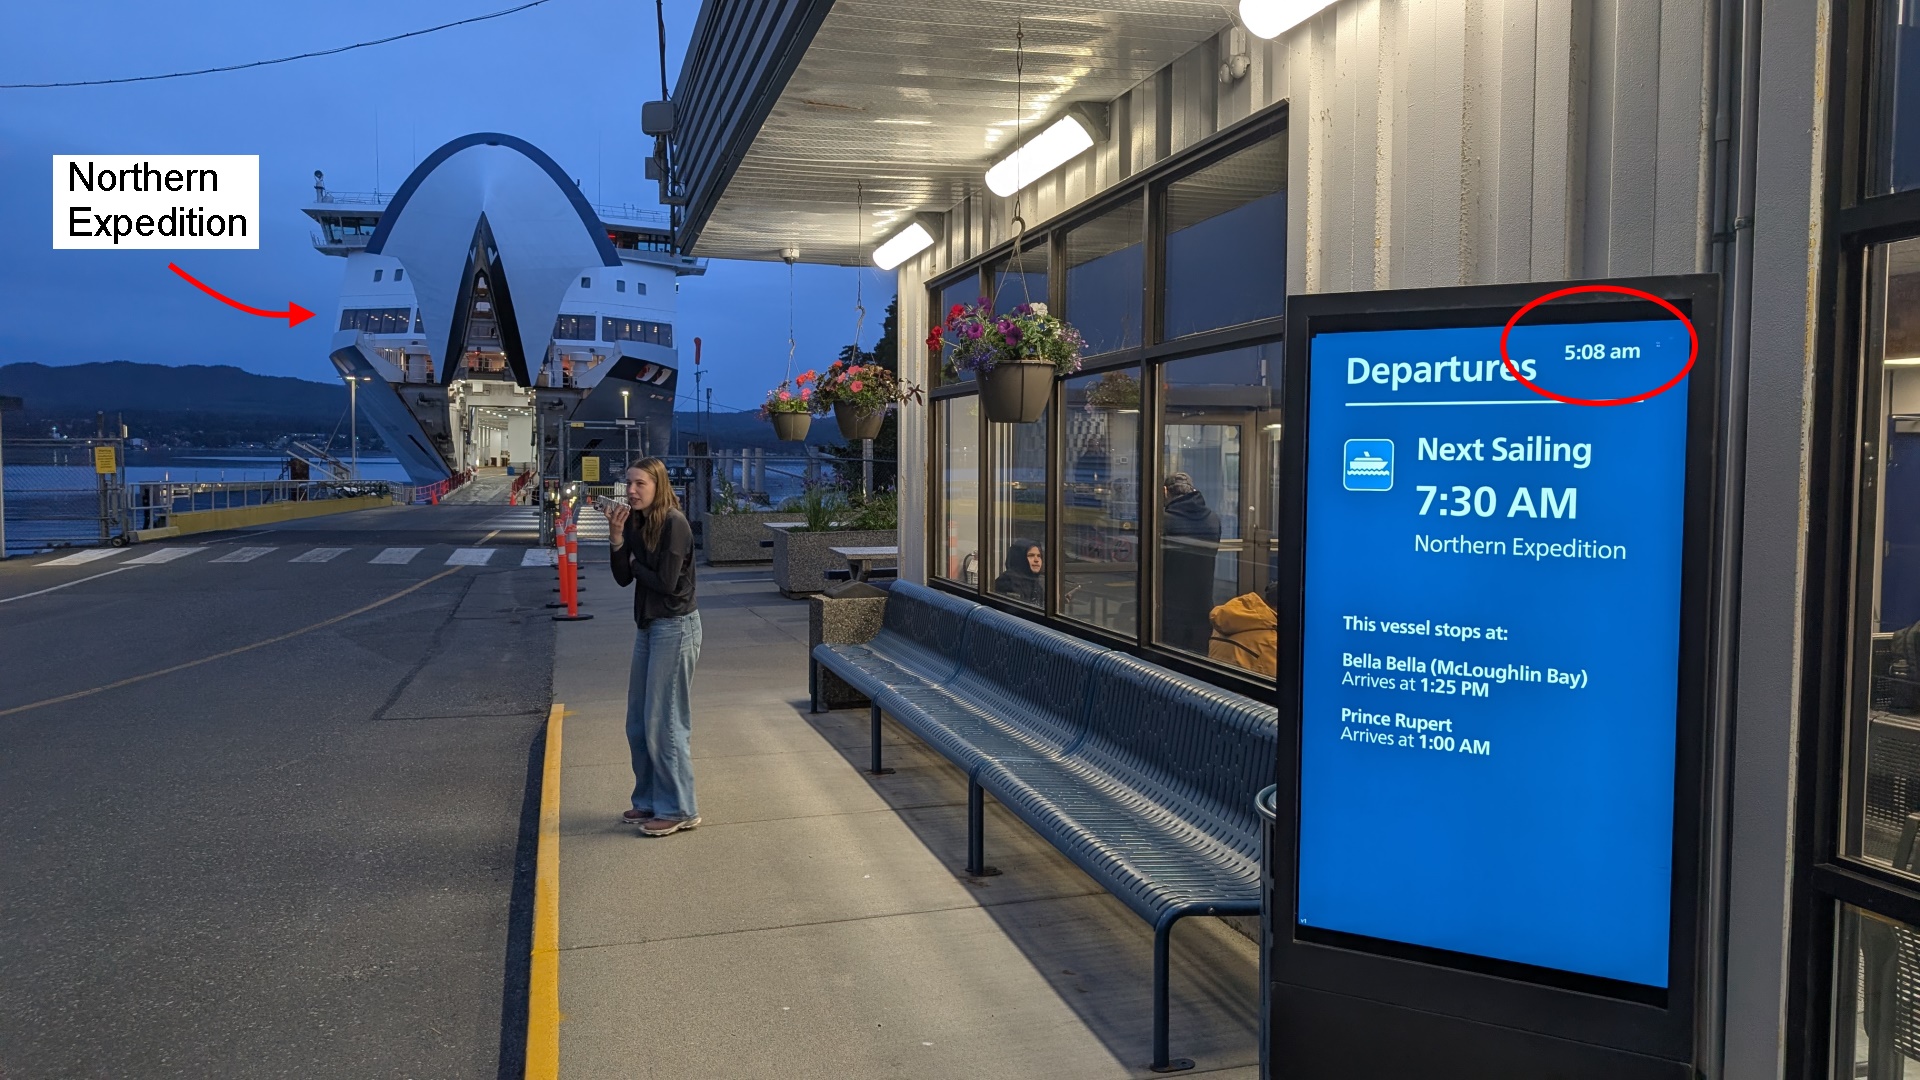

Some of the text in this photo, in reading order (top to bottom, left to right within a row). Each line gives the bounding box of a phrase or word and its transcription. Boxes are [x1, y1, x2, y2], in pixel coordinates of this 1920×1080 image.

[1564, 343, 1641, 361] 5:08 am
[1346, 355, 1537, 391] Departures
[1417, 435, 1592, 469] Next Sailing
[1415, 485, 1578, 520] 7:30 AM
[1414, 534, 1627, 562] Northern Expedition
[1342, 615, 1508, 643] This vessel stops at:
[1341, 671, 1490, 698] Arrives at 1:25 PM
[1342, 652, 1588, 690] Bella Bella (McLoughlin Bay)
[1341, 707, 1453, 735] Prince Rupert
[1340, 726, 1491, 756] Arrives at 1:00 AM
